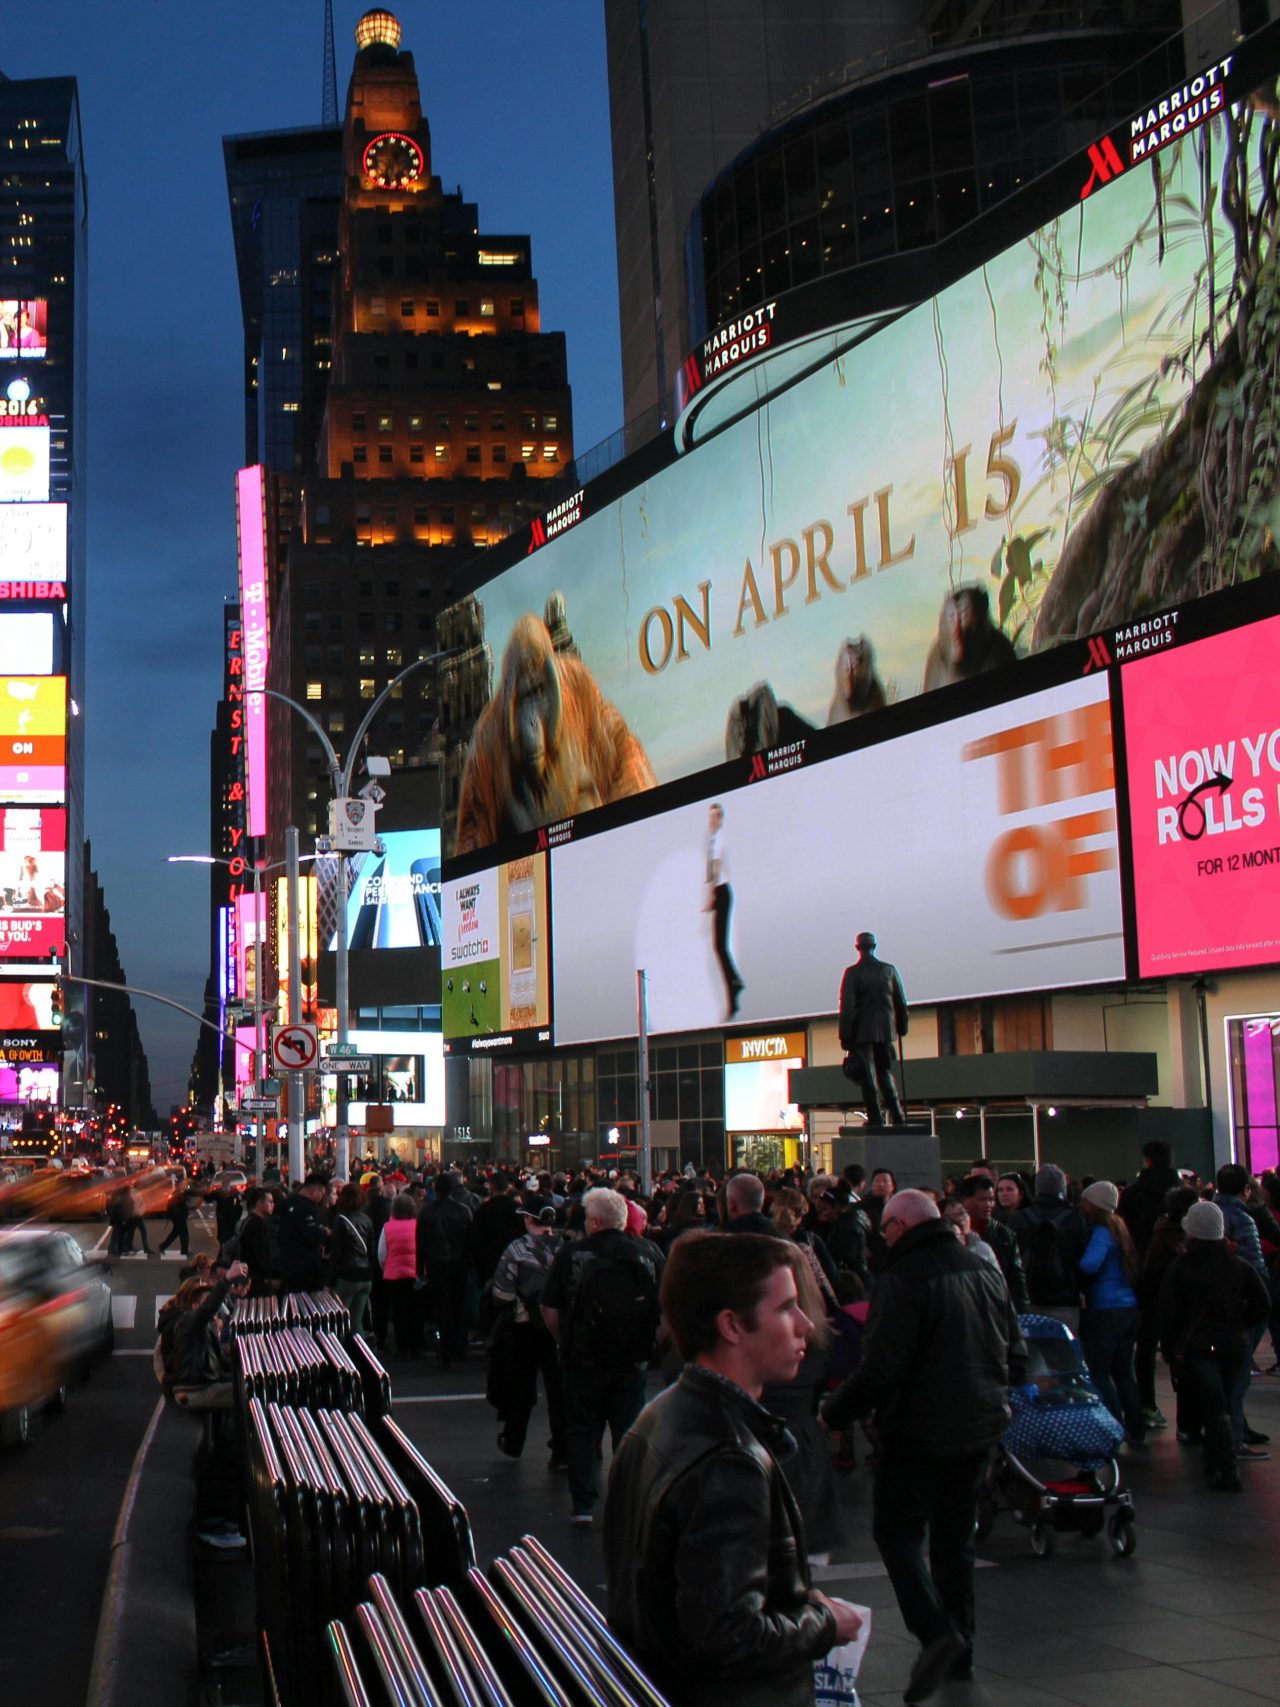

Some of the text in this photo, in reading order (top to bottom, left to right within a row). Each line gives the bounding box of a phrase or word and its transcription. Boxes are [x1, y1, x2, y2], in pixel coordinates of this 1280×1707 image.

[1131, 54, 1236, 138] MARRIOTT
[1131, 88, 1222, 160] MARQUIS
[703, 302, 777, 358] MARRIOTT
[704, 328, 767, 377] MARQUIS
[546, 489, 585, 523] MARRIOTT
[546, 508, 581, 539] MARQUIS
[637, 418, 1021, 677] ON APRIL 15
[1115, 611, 1179, 643] MARRIOTT
[1116, 630, 1172, 659] MARQUIS
[228, 630, 245, 756] ERNST
[12, 742, 33, 755] ON
[767, 739, 806, 761] MARRIOTT
[768, 753, 802, 773] MARQUIS
[1154, 740, 1236, 800] NOW
[548, 819, 574, 836] MARRIOTT
[548, 830, 572, 845] MARQUIS
[1197, 857, 1223, 876] FOR
[1227, 854, 1240, 871] 12
[459, 884, 480, 900] ALWAYS
[460, 897, 476, 912] WANT
[7, 930, 32, 942] YOU.
[10, 919, 43, 931] BUD'S
[451, 938, 483, 960] swatch
[3, 1039, 38, 1047] SONY
[329, 1046, 338, 1055] W
[741, 1036, 788, 1059] INVICTA
[322, 1060, 368, 1070] ONE WAY
[453, 1127, 471, 1137] 1515
